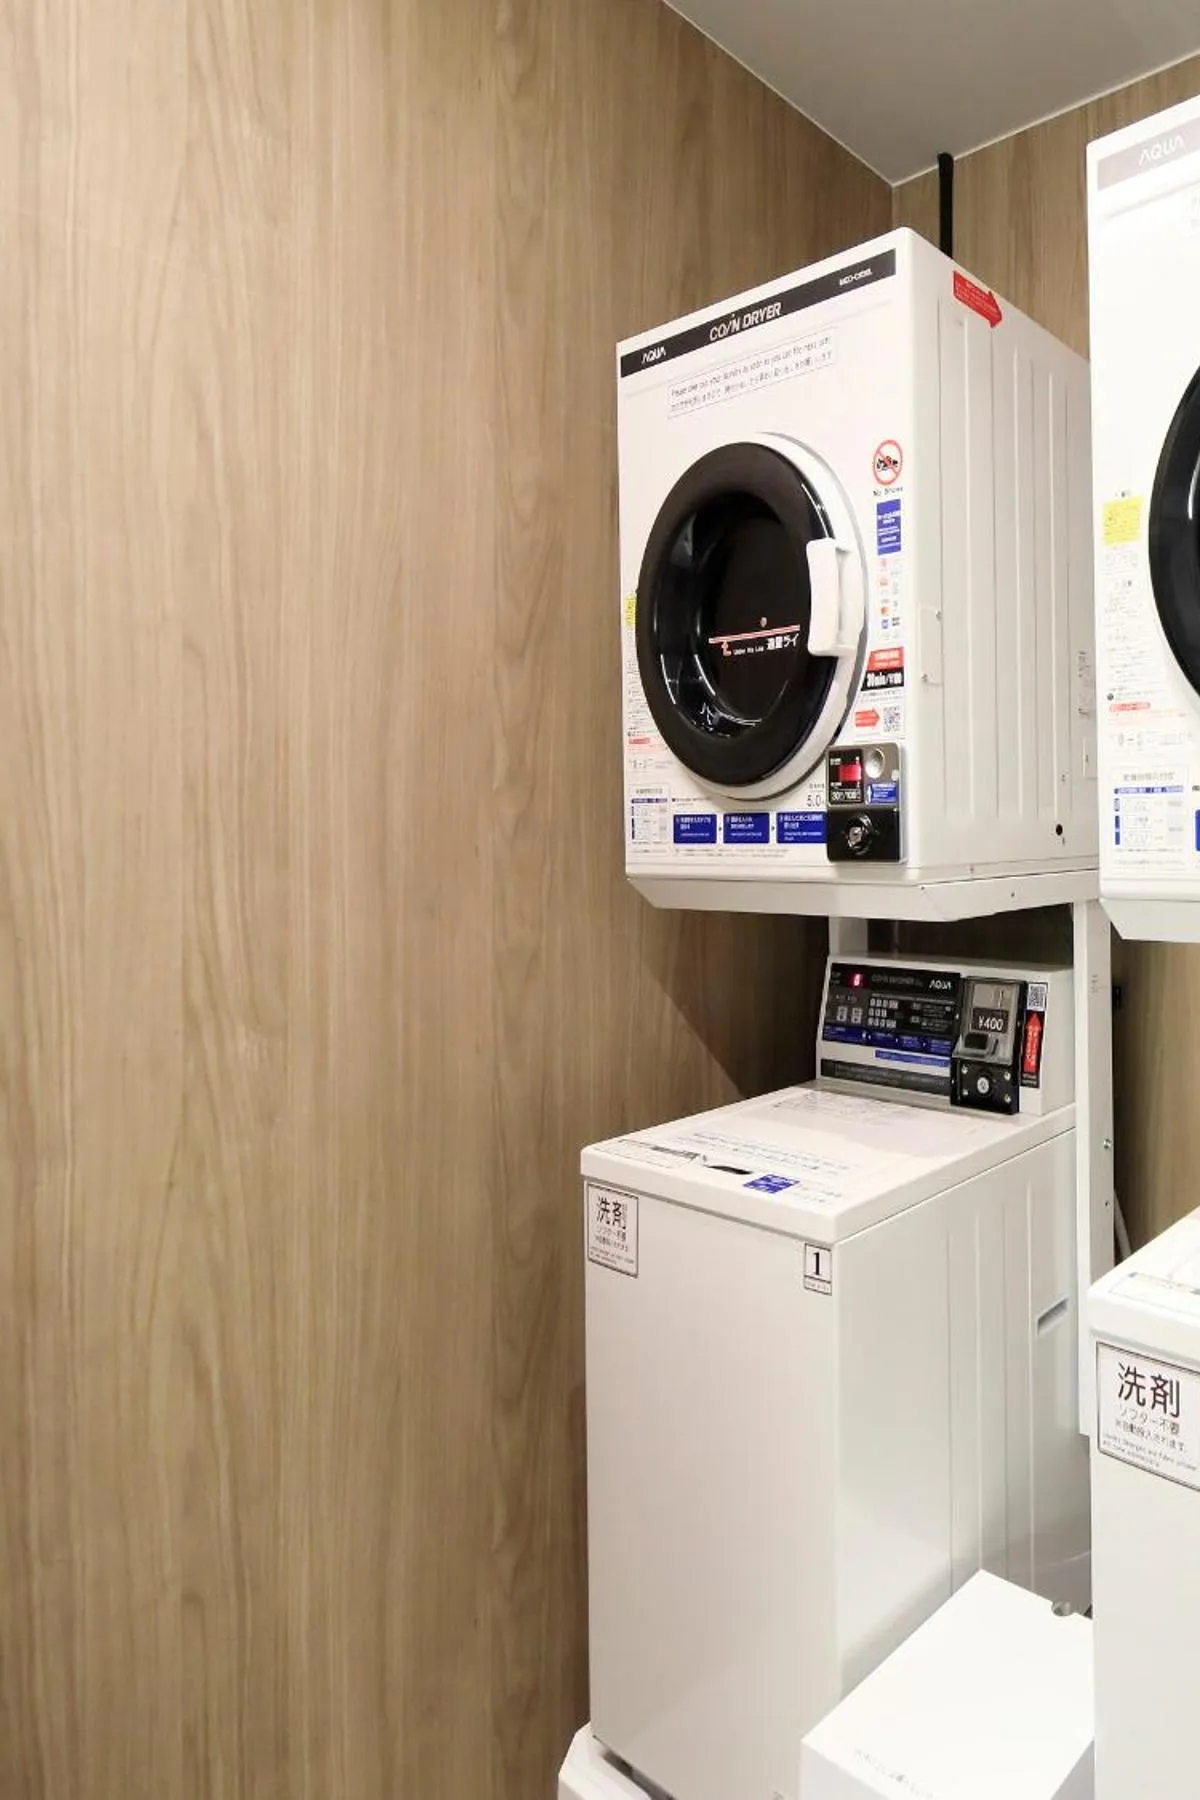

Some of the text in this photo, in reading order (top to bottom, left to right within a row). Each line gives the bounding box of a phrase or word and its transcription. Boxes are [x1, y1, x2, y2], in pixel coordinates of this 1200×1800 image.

[1138, 135, 1185, 165] AQUA
[742, 302, 782, 330] DRYER
[767, 634, 800, 651] 適量ライ
[978, 1015, 1004, 1031] ¥400
[813, 1251, 821, 1276] 1
[1118, 1362, 1180, 1418] 洗剤
